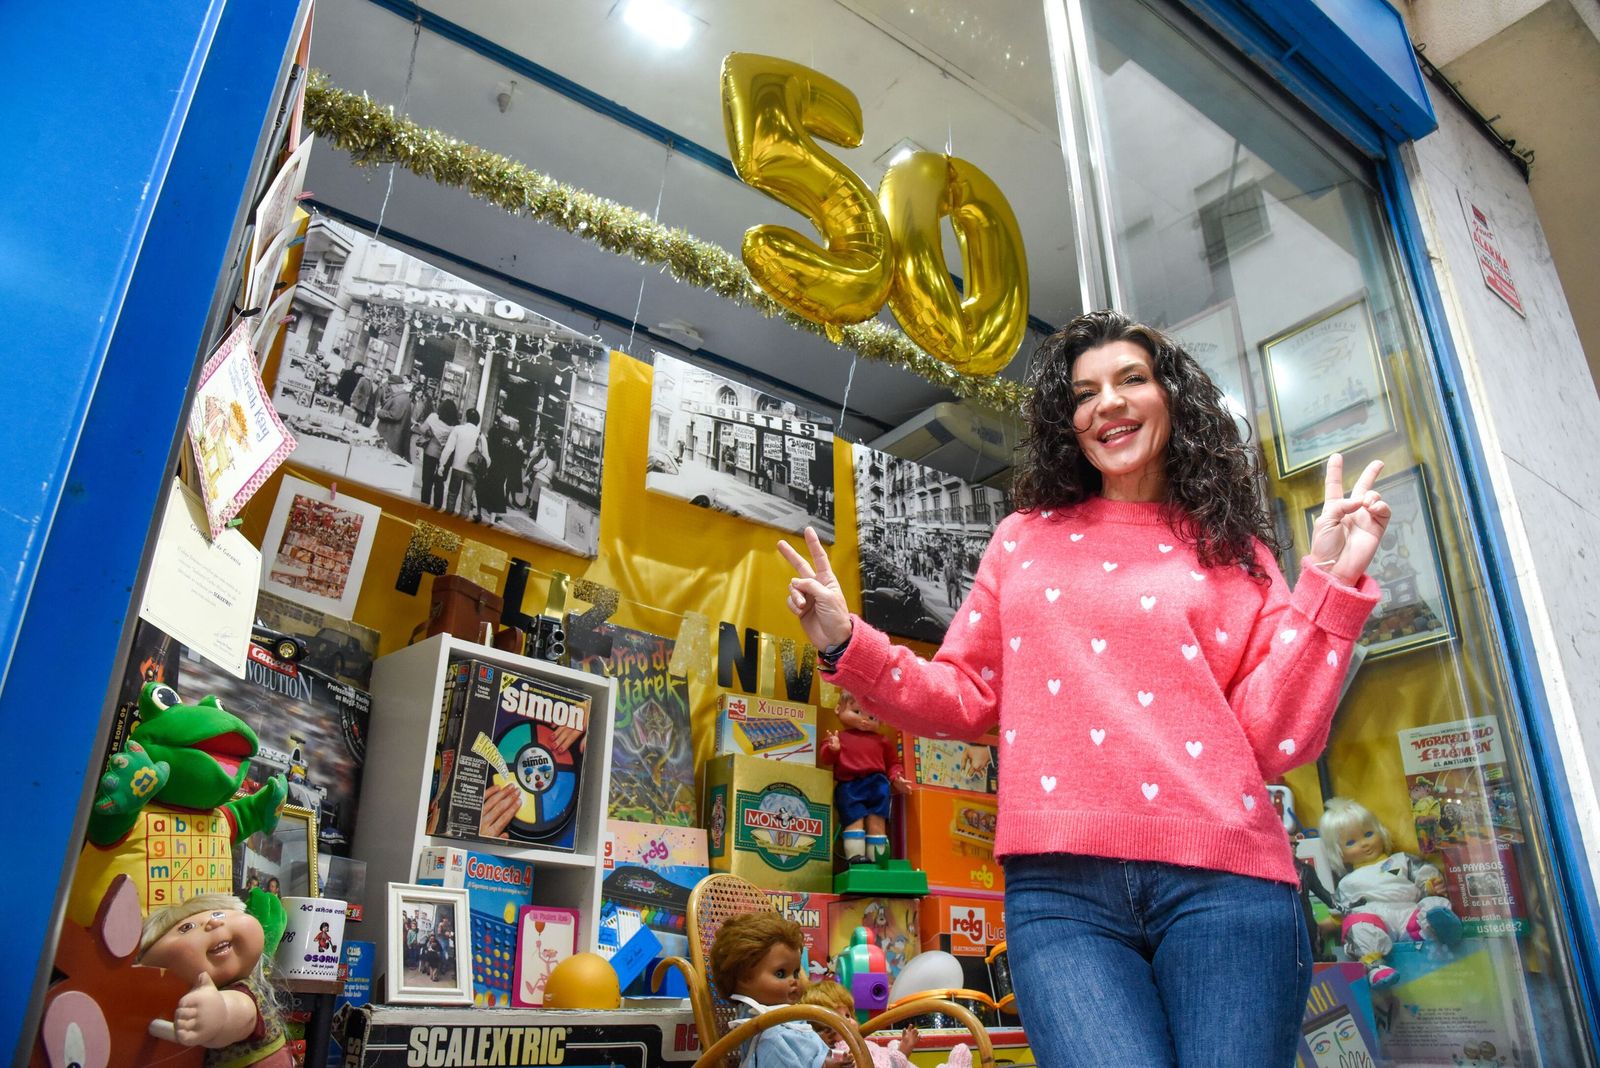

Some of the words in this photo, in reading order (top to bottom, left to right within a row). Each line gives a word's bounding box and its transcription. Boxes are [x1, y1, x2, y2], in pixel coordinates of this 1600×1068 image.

[720, 51, 1030, 377] 50
[247, 660, 313, 704] VOLUTION
[501, 683, 585, 731] simon
[522, 757, 549, 768] simon
[746, 811, 820, 834] MONOPOLY
[642, 839, 669, 865] roig
[1462, 860, 1505, 872] PAYASOS
[467, 856, 522, 884] Conecta
[522, 866, 533, 890] 4
[952, 909, 983, 942] roig
[1477, 921, 1522, 934] ustedes?
[407, 1027, 567, 1068] SCALEXTRIC
